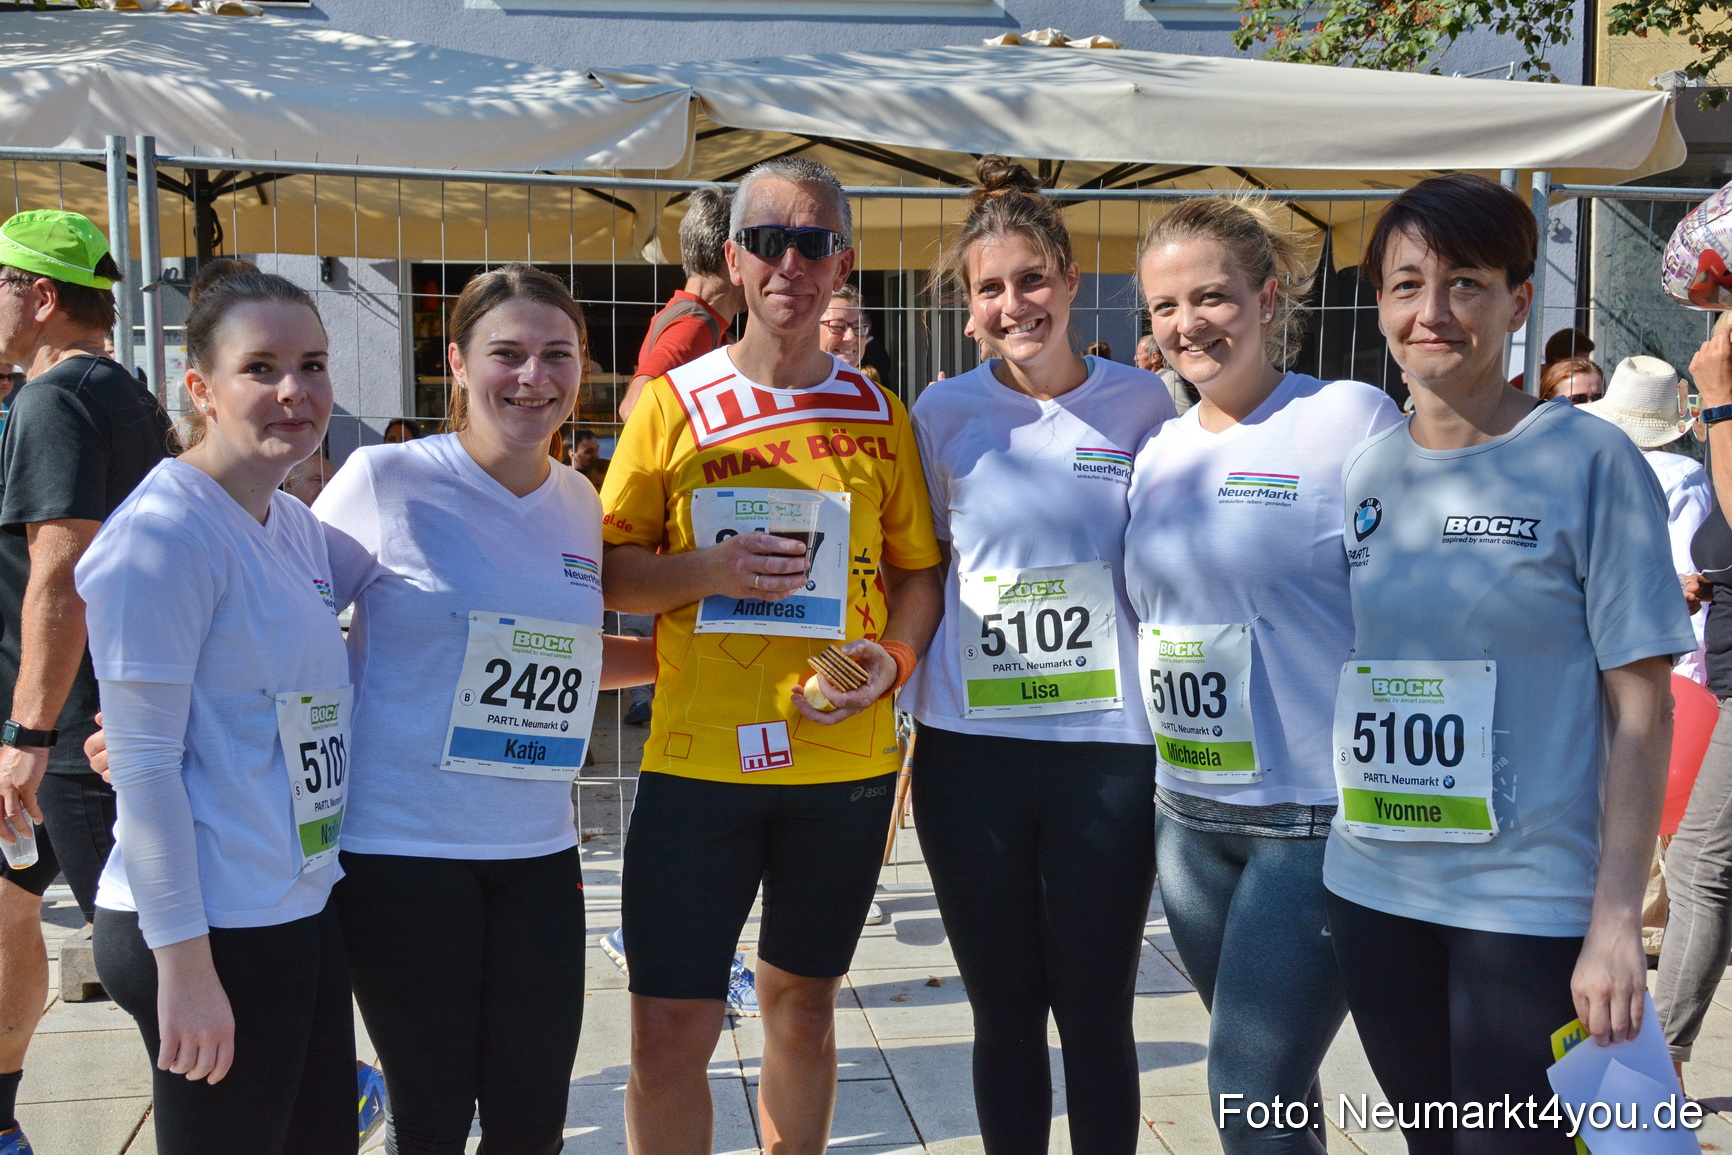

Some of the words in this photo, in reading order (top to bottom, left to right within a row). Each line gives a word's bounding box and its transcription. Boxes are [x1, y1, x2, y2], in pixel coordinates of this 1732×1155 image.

[702, 440, 798, 484] MAX
[806, 428, 896, 462] BÖGL
[1073, 462, 1130, 479] NeuerMark
[1217, 487, 1299, 501] NeuerMarkt
[602, 513, 633, 533] gl.de
[1443, 515, 1541, 541] BOCK
[1442, 536, 1467, 544] inspired
[1469, 536, 1478, 544] by
[1501, 538, 1537, 548] concepts
[999, 579, 1067, 599] BOCK
[733, 598, 806, 619] Andreas
[513, 630, 575, 653] BOCK
[981, 606, 1093, 657] 5102
[1159, 640, 1205, 657] BOCK
[992, 661, 1025, 673] PARTL
[1026, 658, 1072, 670] Neumarkt
[480, 658, 582, 714] 2428
[1021, 681, 1060, 700] Lisa
[1150, 668, 1227, 719] 5103
[1372, 678, 1444, 697] BOCK
[487, 714, 520, 727] PARTL
[521, 719, 558, 730] Neumarkt
[1161, 720, 1178, 733] PARTL
[1178, 724, 1210, 736] Neumarkt
[1353, 712, 1464, 767] 5100
[504, 738, 547, 764] Katja
[1167, 741, 1222, 766] Michaela
[1491, 757, 1508, 775] 018
[1364, 772, 1390, 785] PARTL
[1392, 774, 1439, 787] Neumarkt
[865, 785, 887, 797] asics
[1374, 797, 1442, 822] Yvonne
